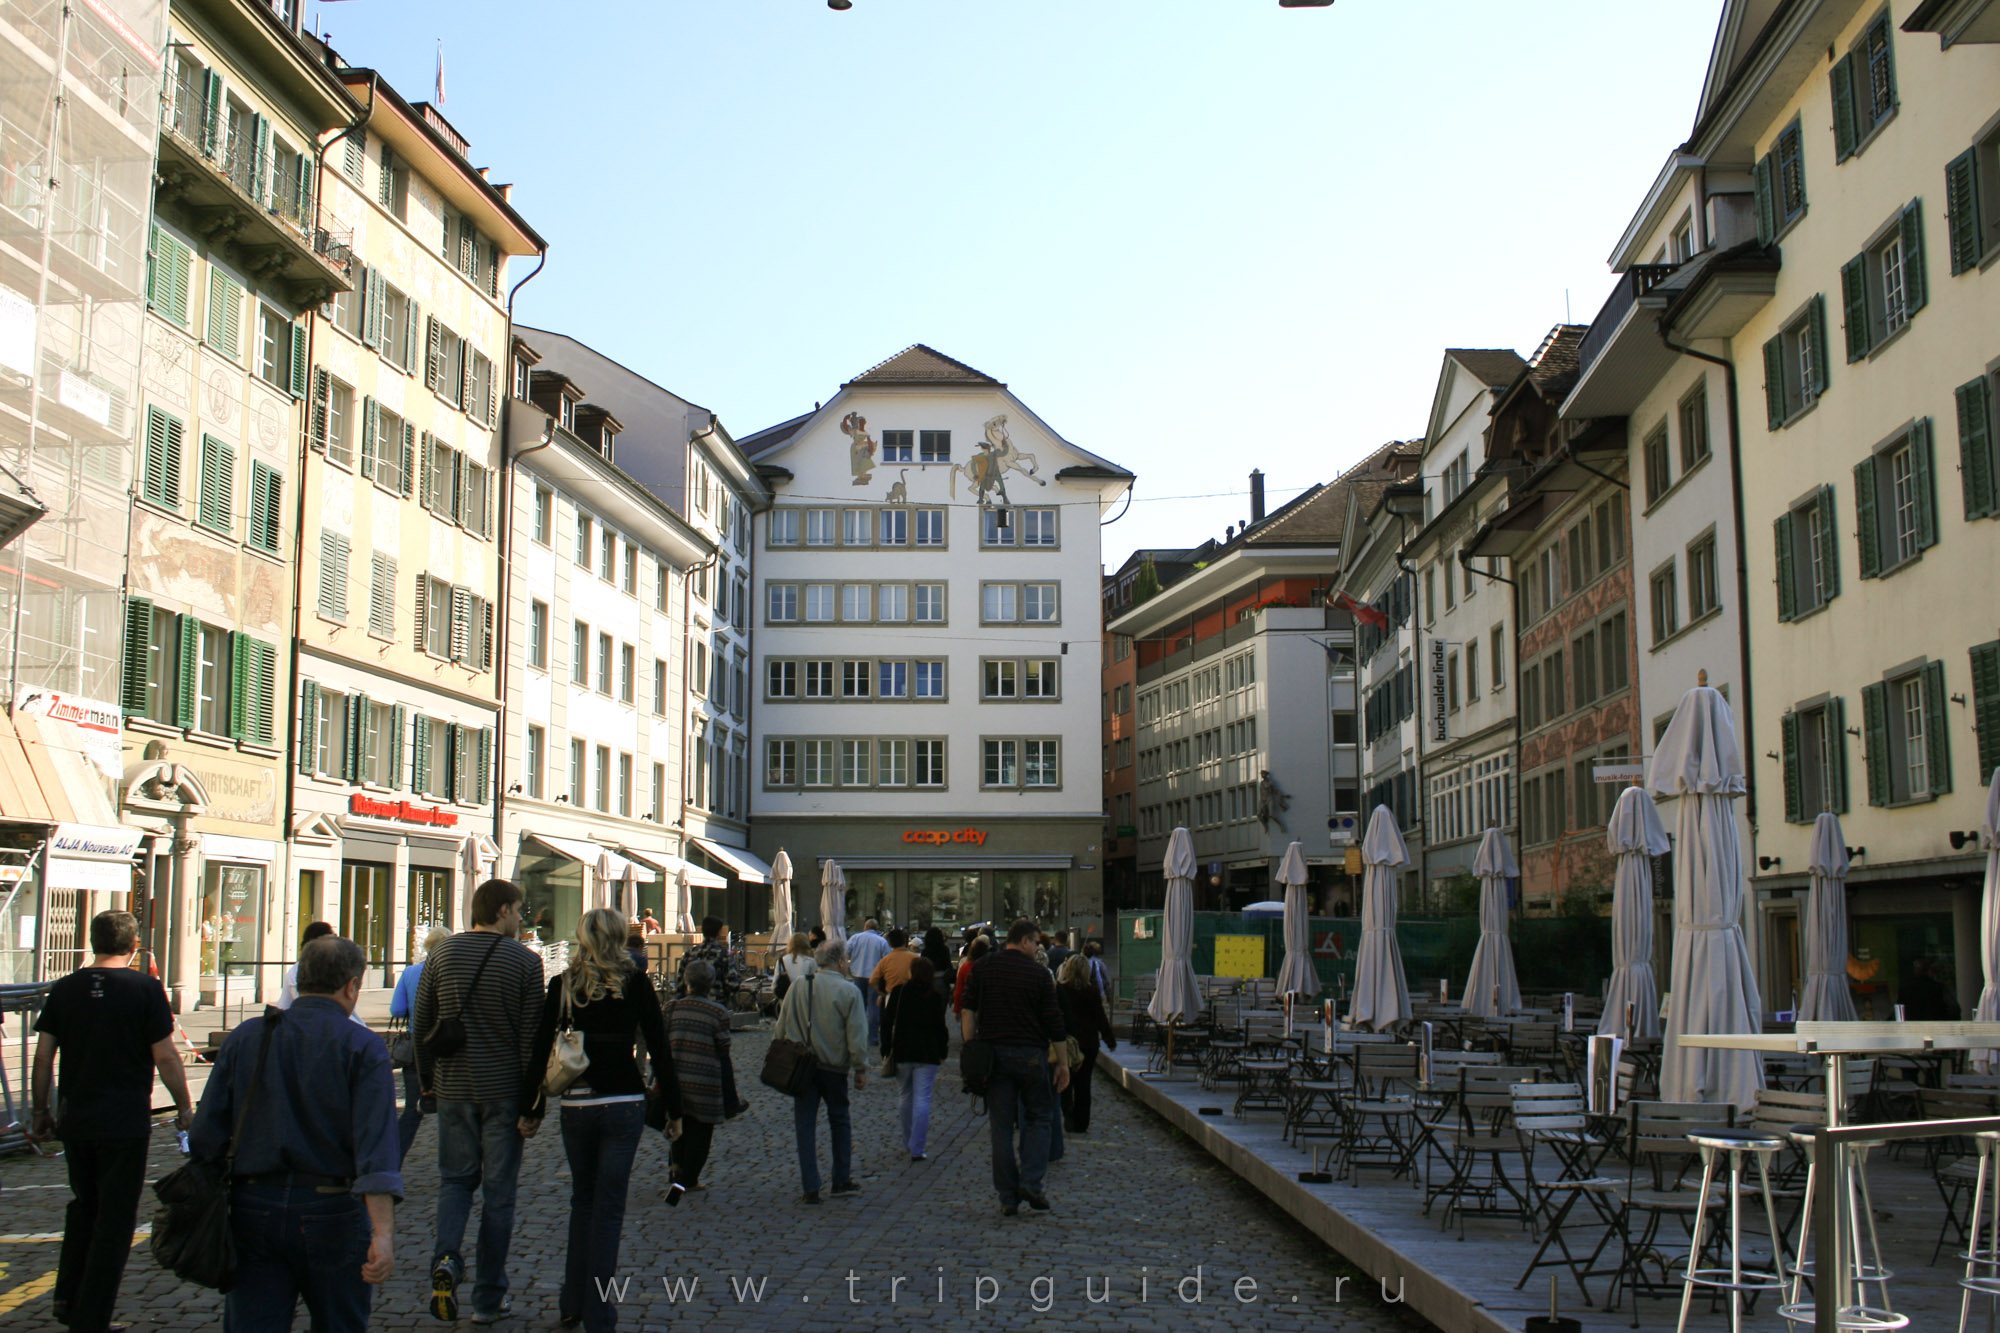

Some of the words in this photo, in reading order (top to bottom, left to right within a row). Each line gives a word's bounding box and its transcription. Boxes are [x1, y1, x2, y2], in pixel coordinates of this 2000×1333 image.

[1432, 640, 1444, 673] linder
[47, 695, 119, 728] Zimmermann
[1433, 674, 1446, 741] buchwalder
[54, 837, 81, 851] ALJA
[81, 840, 120, 855] Nouveau
[119, 844, 133, 855] AG
[902, 830, 951, 846] coop
[952, 827, 988, 846] city
